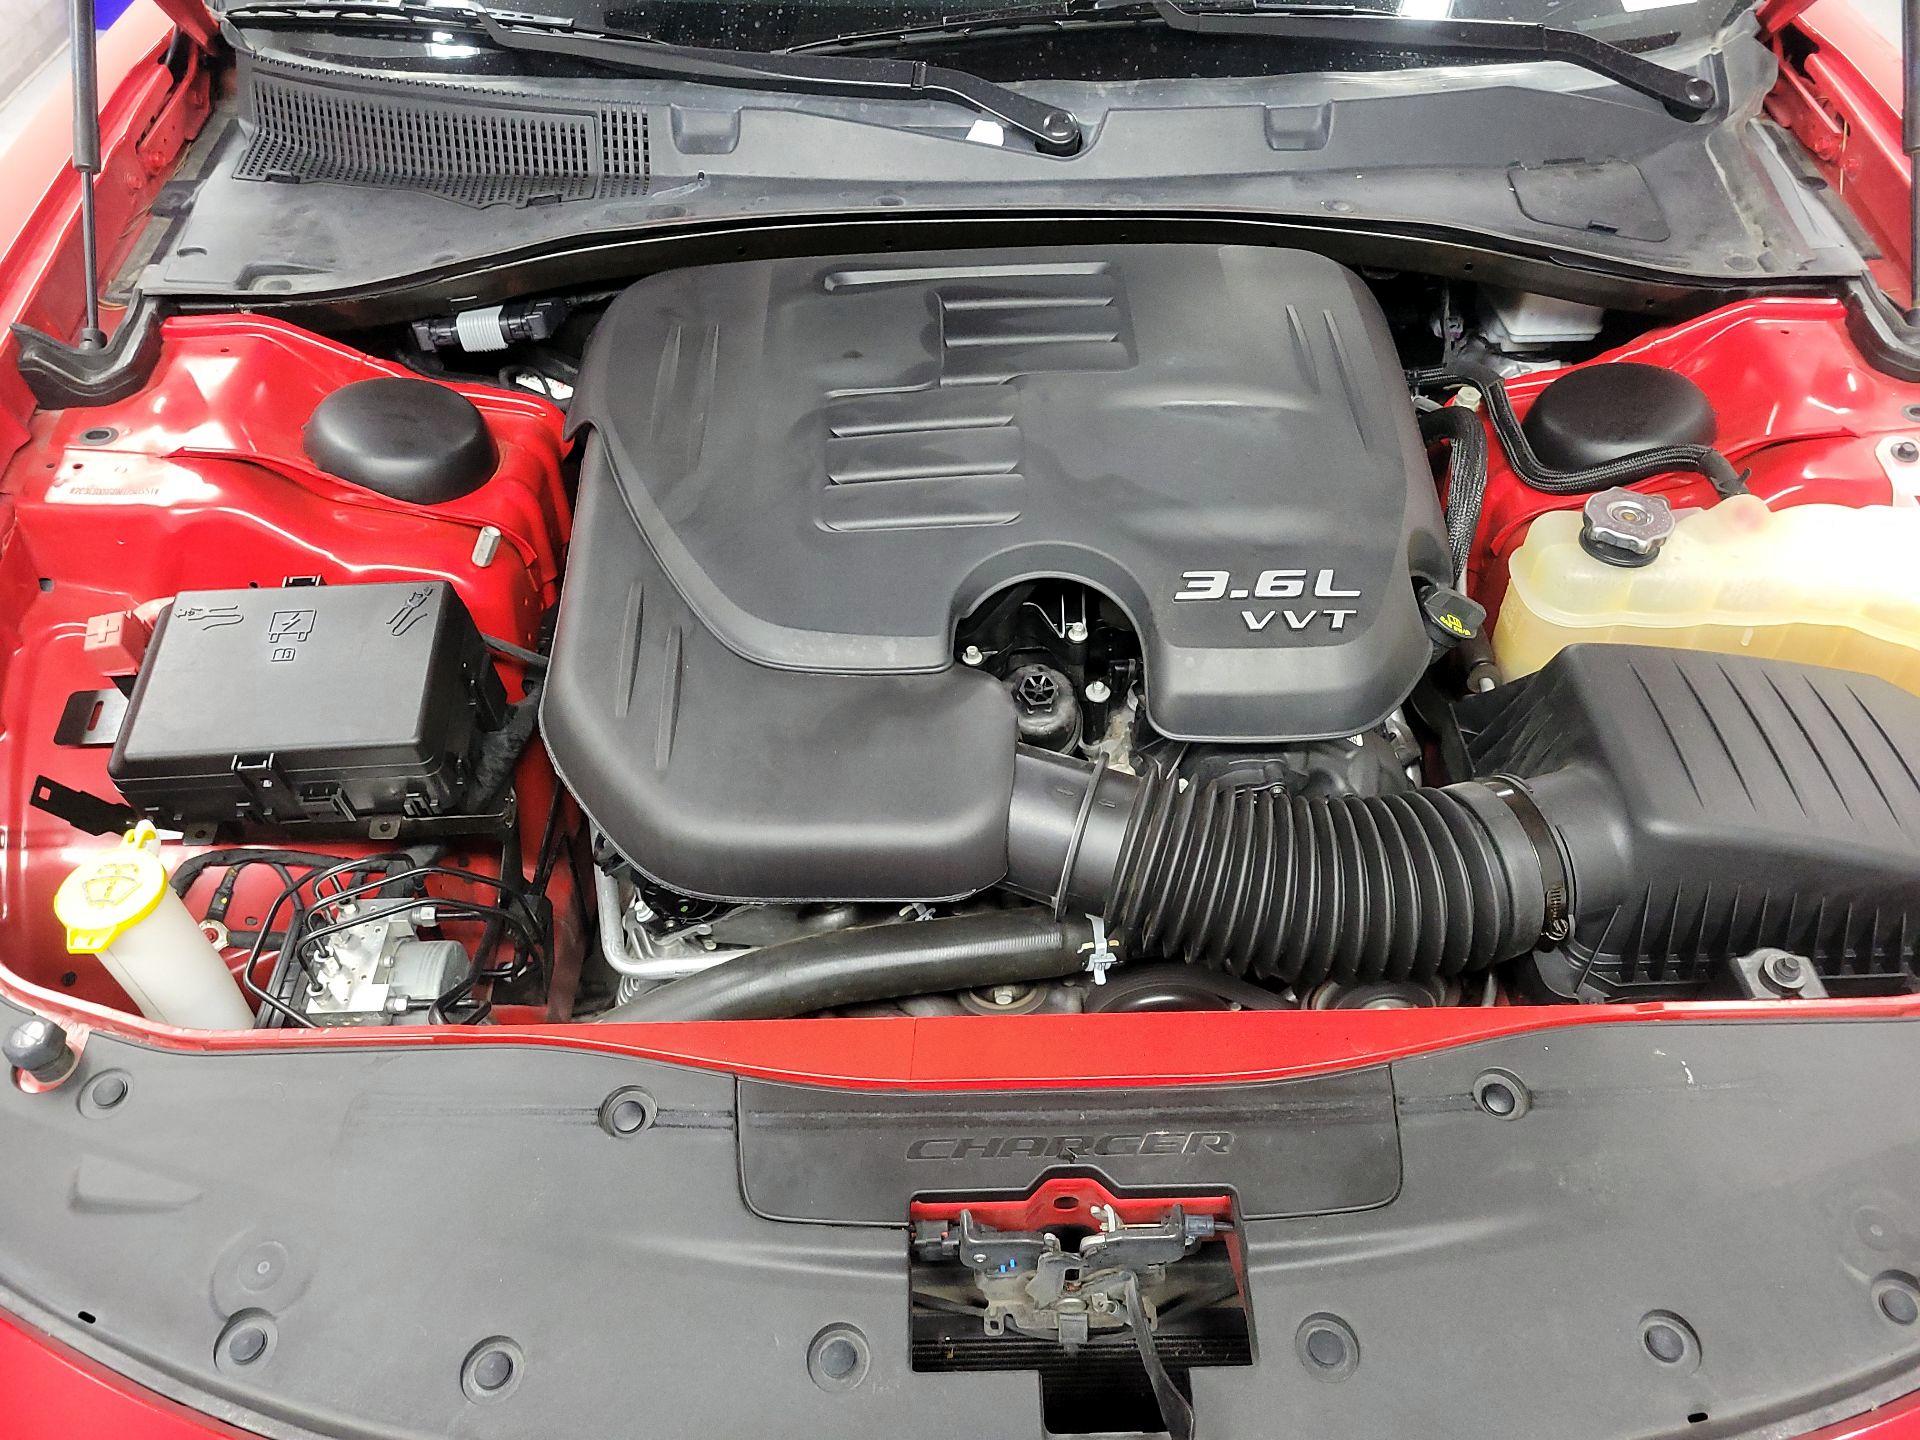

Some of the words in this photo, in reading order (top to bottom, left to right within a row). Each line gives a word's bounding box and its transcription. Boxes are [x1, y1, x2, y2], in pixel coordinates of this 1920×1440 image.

[1173, 569, 1361, 601] 3.6L
[1241, 609, 1358, 631] VVT
[906, 1131, 1235, 1160] CHARGER
